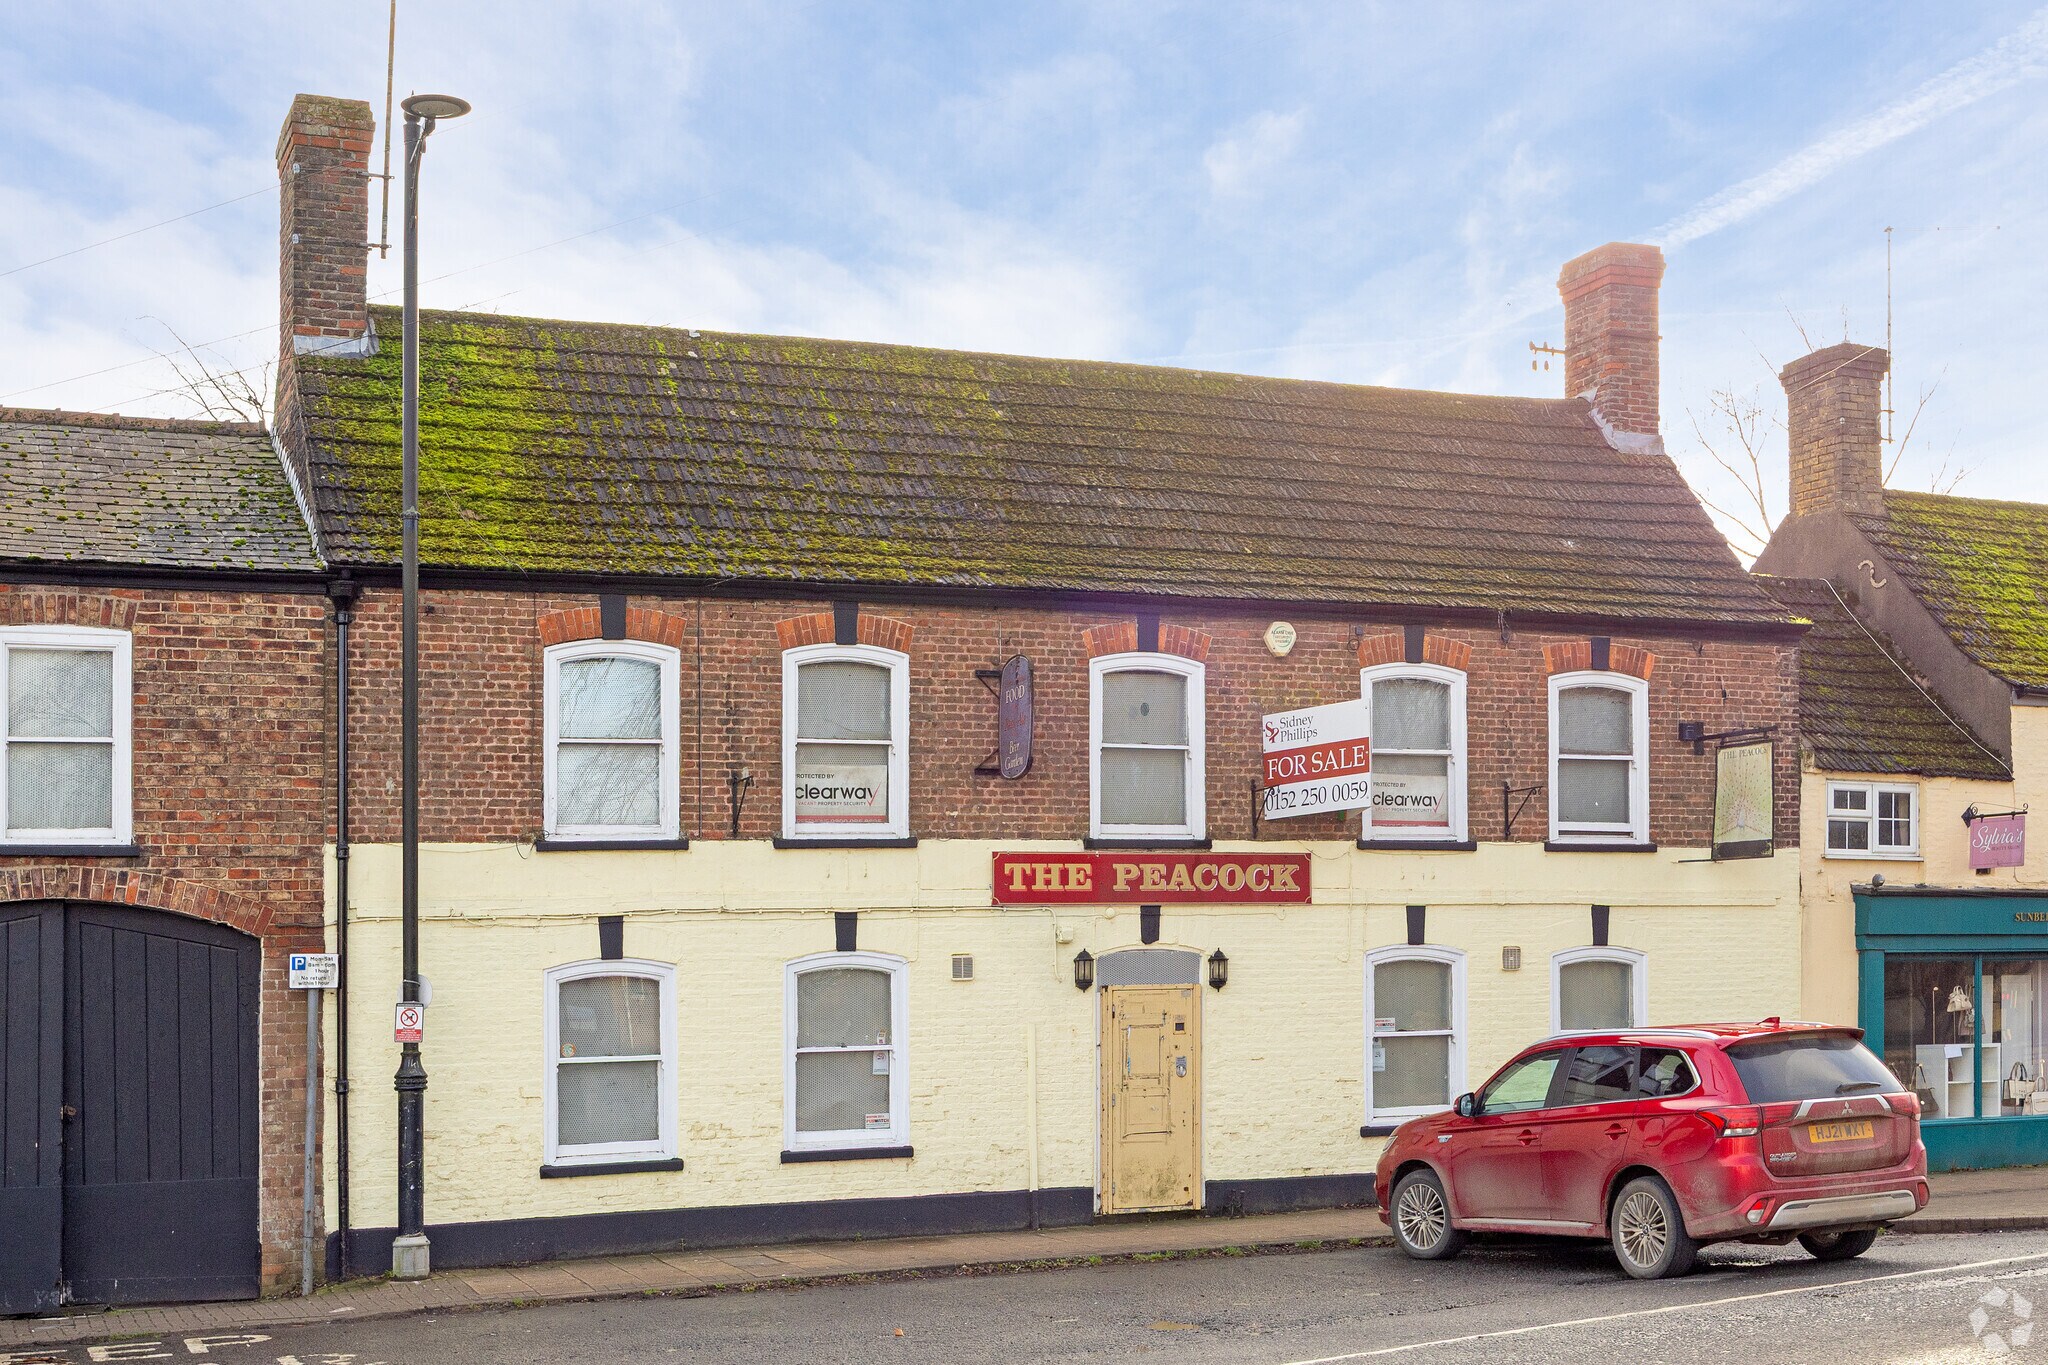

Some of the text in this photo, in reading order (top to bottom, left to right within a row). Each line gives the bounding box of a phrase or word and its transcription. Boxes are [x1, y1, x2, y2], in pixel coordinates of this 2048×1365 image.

[1005, 684, 1025, 704] FOOD
[1279, 715, 1313, 729] Sidney
[1280, 727, 1318, 742] Phillips
[1009, 740, 1020, 755] Beer
[1723, 750, 1738, 760] THE
[1004, 755, 1024, 770] Garden
[1267, 745, 1366, 780] FOR SALE
[795, 782, 881, 806] clearway
[1265, 780, 1368, 812] 0152 250 0059
[1372, 791, 1445, 813] clearway
[1972, 825, 2024, 853] Sylvia's
[1004, 862, 1301, 892] THE PEACOCK
[294, 957, 305, 970] P
[1815, 1121, 1867, 1140] HJ21 WXT
